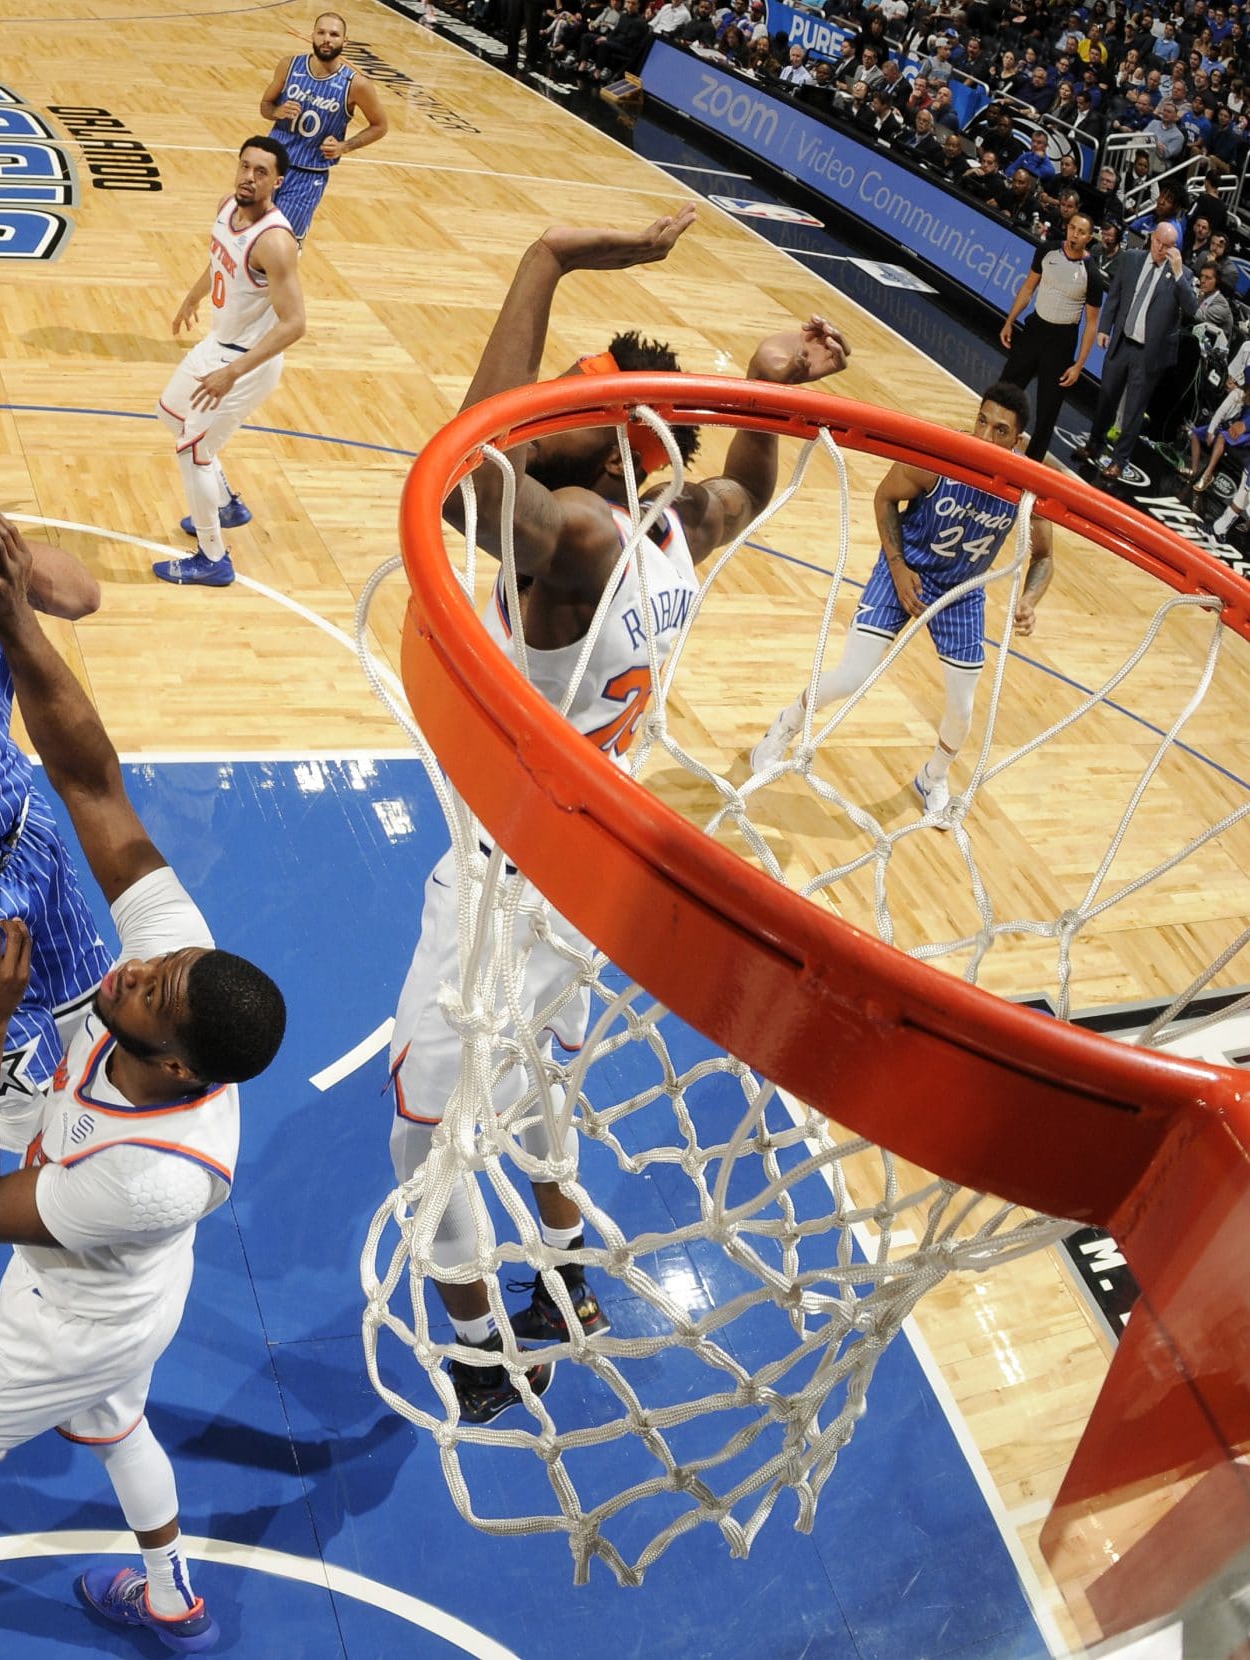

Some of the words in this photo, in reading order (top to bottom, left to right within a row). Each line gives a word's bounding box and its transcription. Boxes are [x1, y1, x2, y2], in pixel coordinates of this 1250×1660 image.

[789, 14, 845, 58] PURE
[46, 105, 163, 192] ORLANDO
[692, 73, 779, 147] zoom
[797, 129, 856, 189] Video
[930, 525, 996, 562] 24
